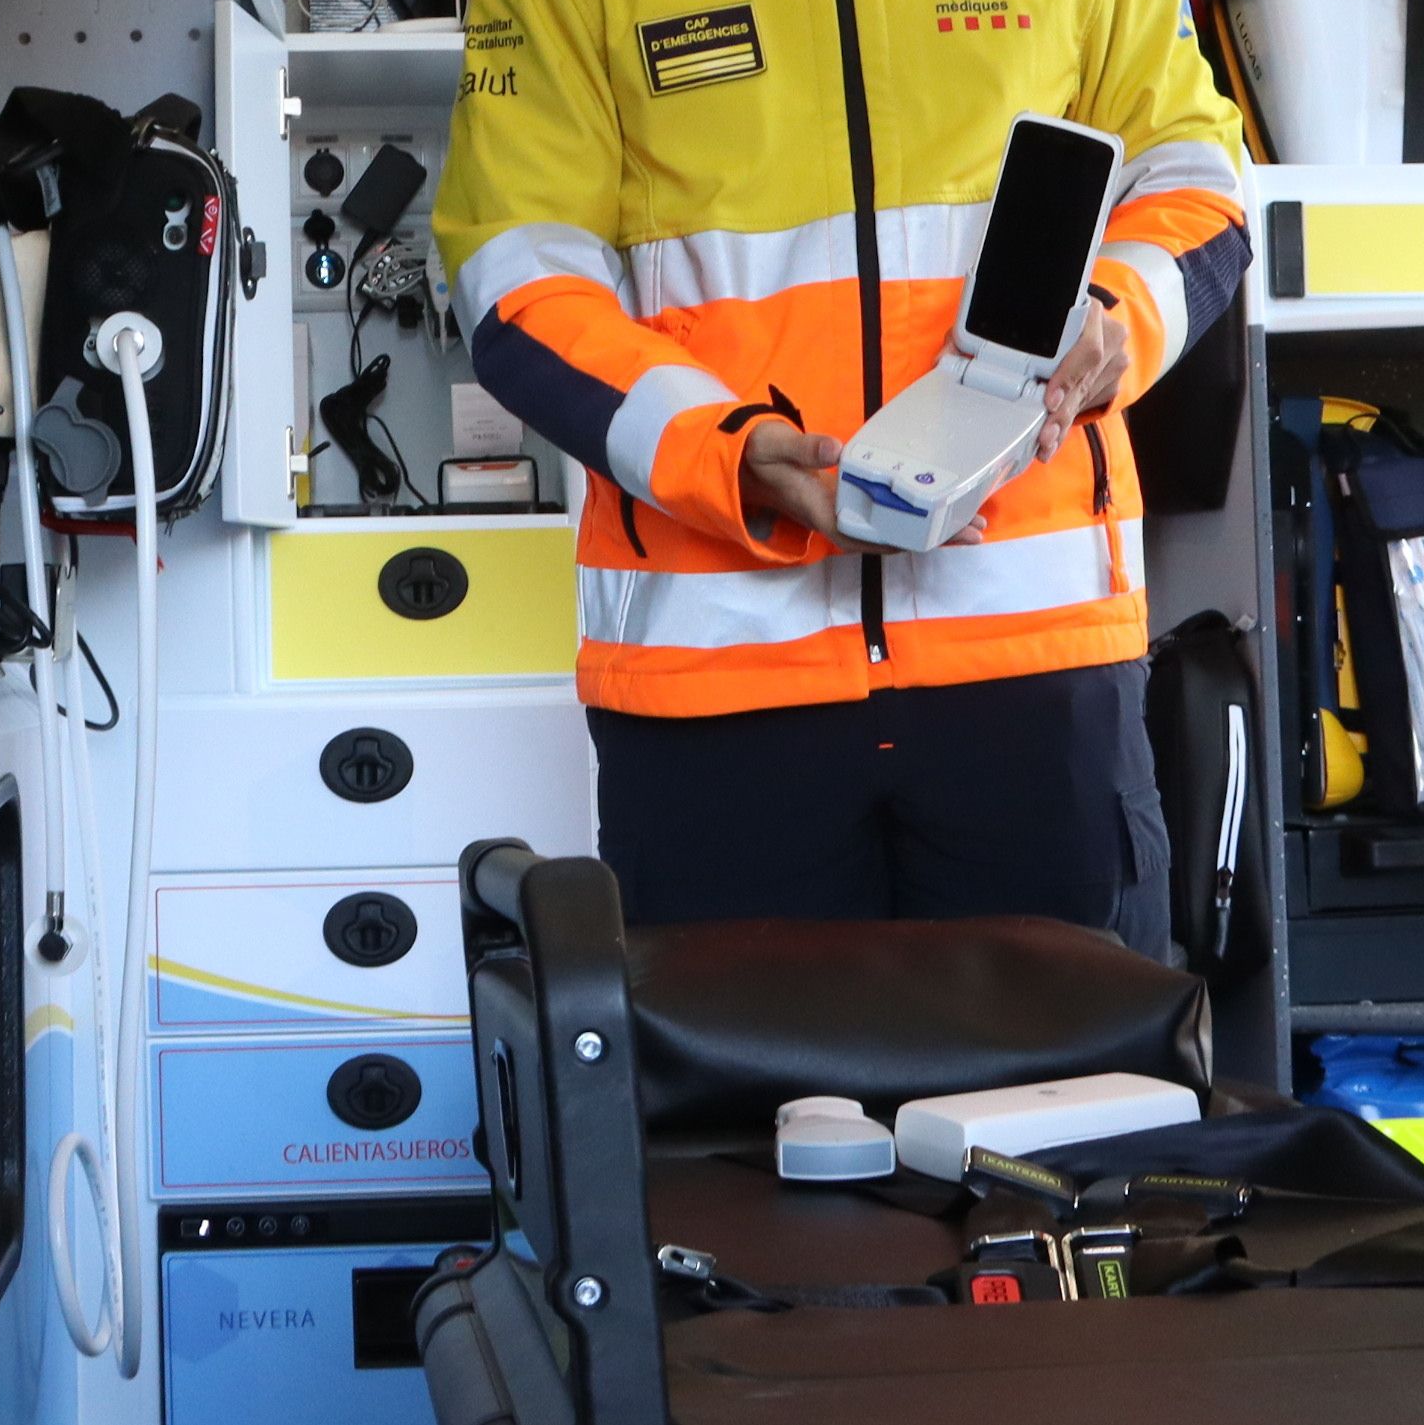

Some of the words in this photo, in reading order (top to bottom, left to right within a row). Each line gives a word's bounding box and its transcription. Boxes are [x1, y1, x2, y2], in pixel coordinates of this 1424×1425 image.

[935, 0, 1009, 14] mèdiques
[684, 16, 710, 31] CAP
[465, 34, 525, 50] Catalunya
[1235, 11, 1263, 81] LUCAS
[282, 1137, 471, 1165] CALIENTASUEROS
[218, 1309, 317, 1331] NEVERA
